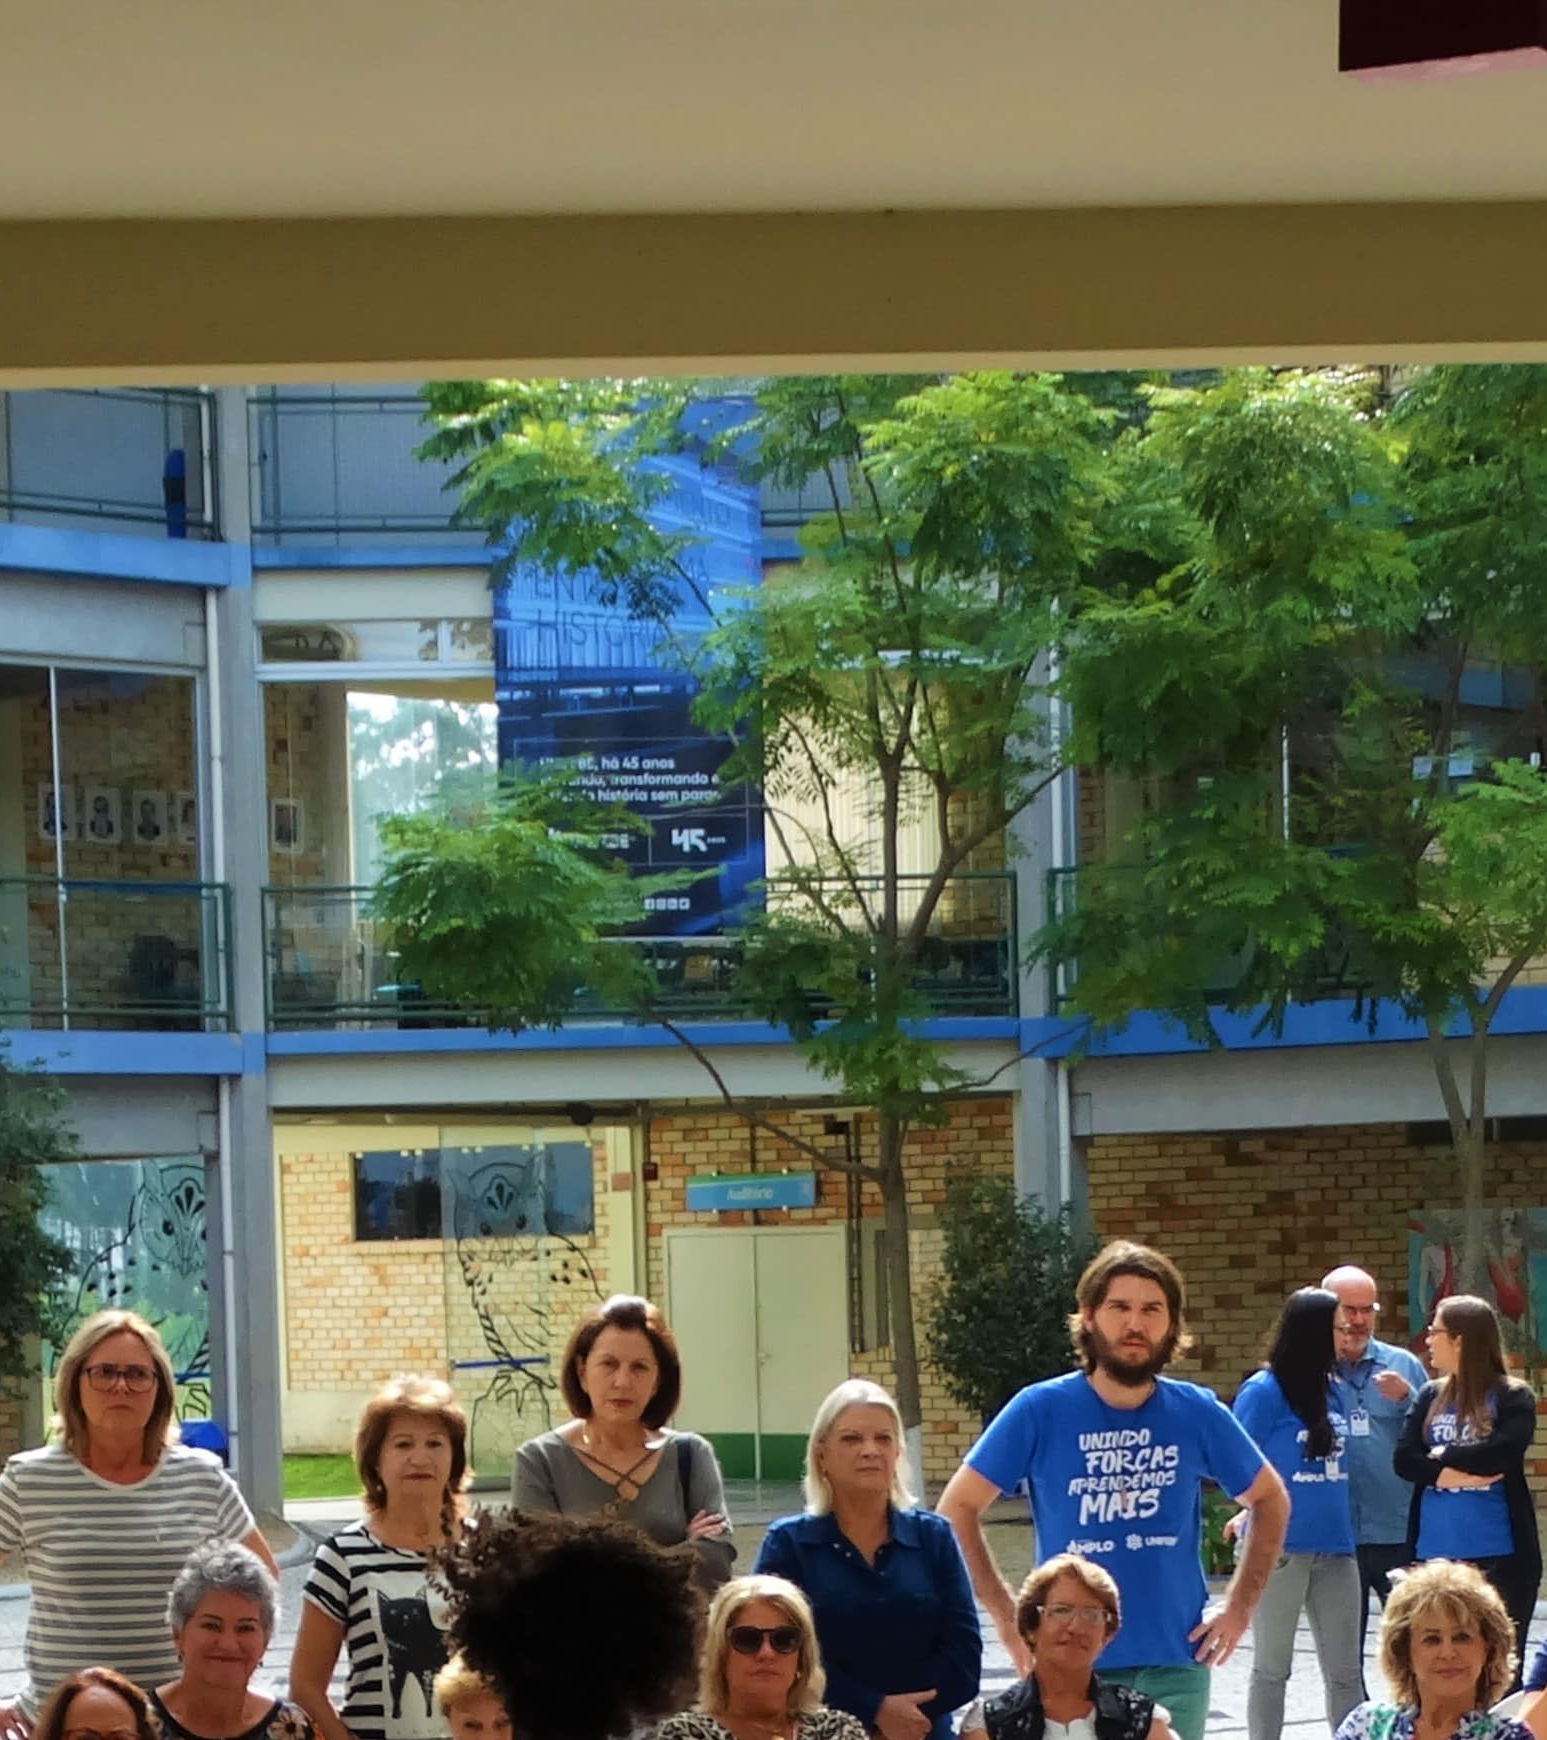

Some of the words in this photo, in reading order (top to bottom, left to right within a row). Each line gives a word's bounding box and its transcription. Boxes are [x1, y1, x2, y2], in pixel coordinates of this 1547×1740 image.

[622, 756, 639, 770] 45
[642, 758, 675, 770] anos
[651, 790, 678, 801] sem
[1078, 1428, 1151, 1451] UNINDO
[1067, 1469, 1176, 1497] APRENDEMOS
[1079, 1488, 1160, 1526] MAIS
[1066, 1539, 1115, 1554] AMPLO
